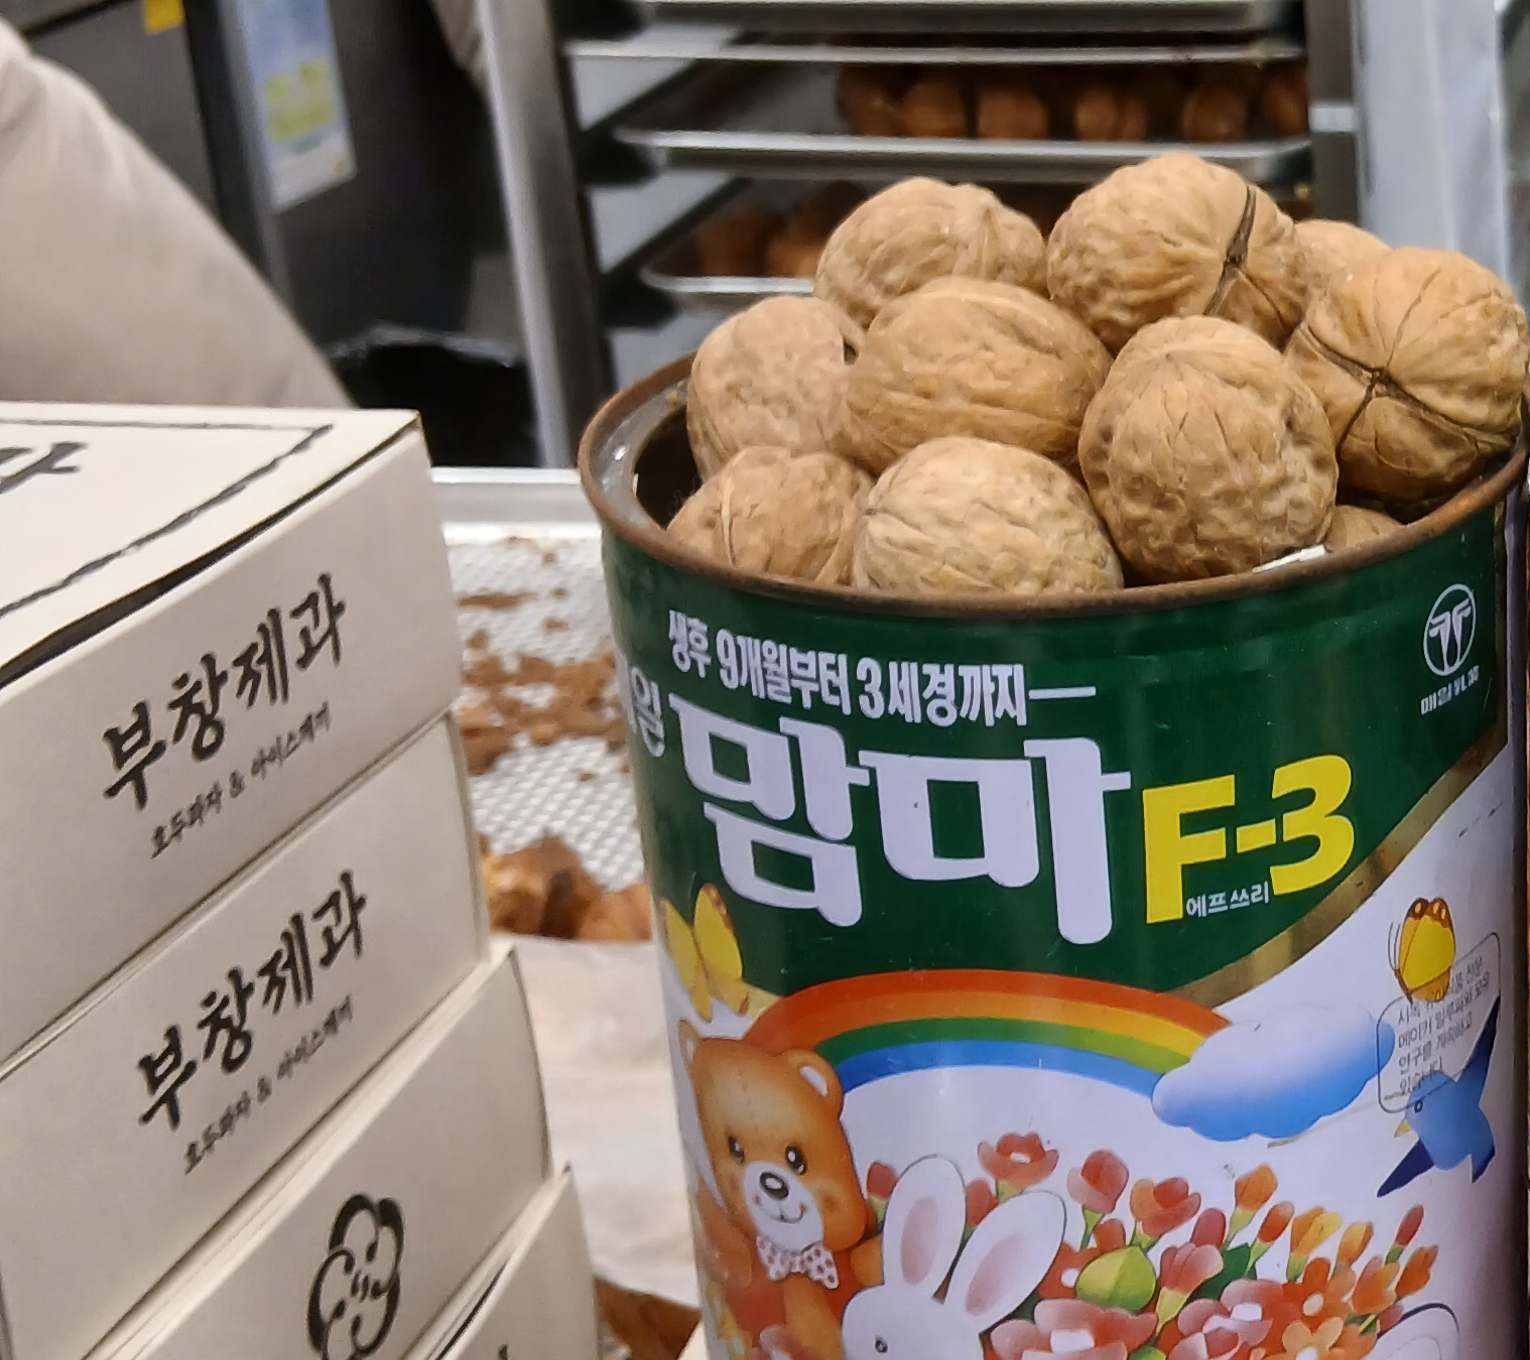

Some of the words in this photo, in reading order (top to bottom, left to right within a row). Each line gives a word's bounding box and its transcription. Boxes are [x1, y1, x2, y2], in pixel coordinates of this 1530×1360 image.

[103, 572, 346, 811] 부창제과
[668, 609, 711, 680] 생후
[716, 628, 851, 716] 9개월부터
[667, 692, 1132, 944] 맘마
[1142, 754, 1355, 924] F-3
[1186, 880, 1270, 918] 에프쓰리
[137, 869, 368, 1132] 부창제과
